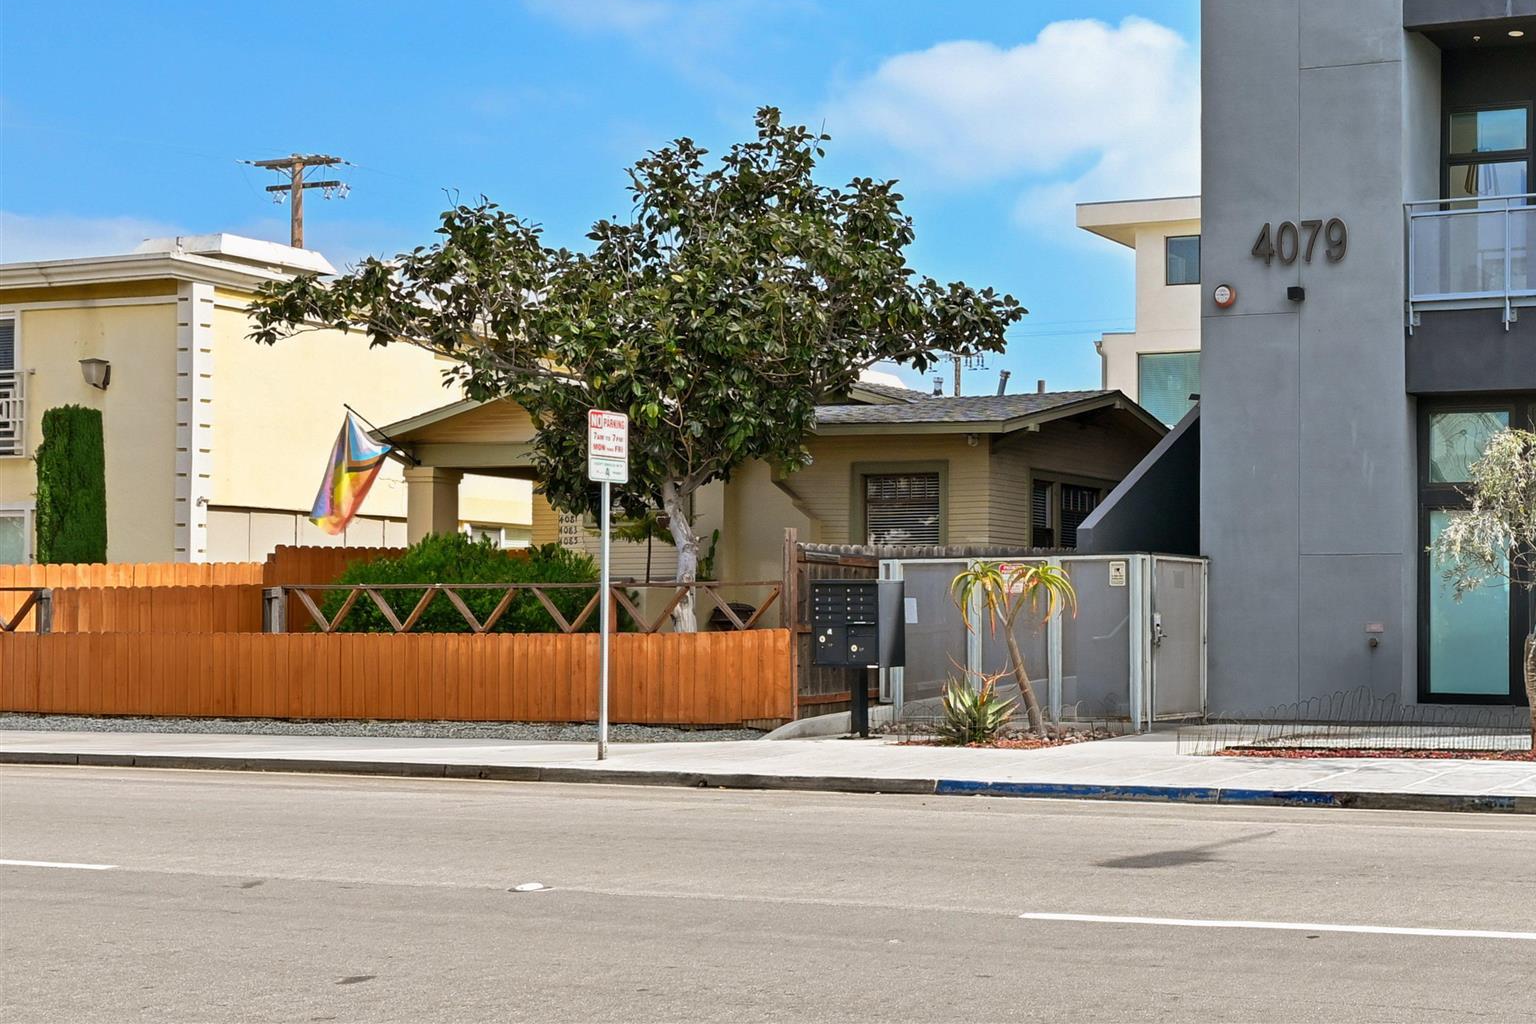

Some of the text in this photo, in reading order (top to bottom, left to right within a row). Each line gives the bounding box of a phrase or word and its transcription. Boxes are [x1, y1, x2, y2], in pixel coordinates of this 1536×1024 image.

[1251, 217, 1348, 265] 4079
[591, 414, 625, 430] NO PARKING
